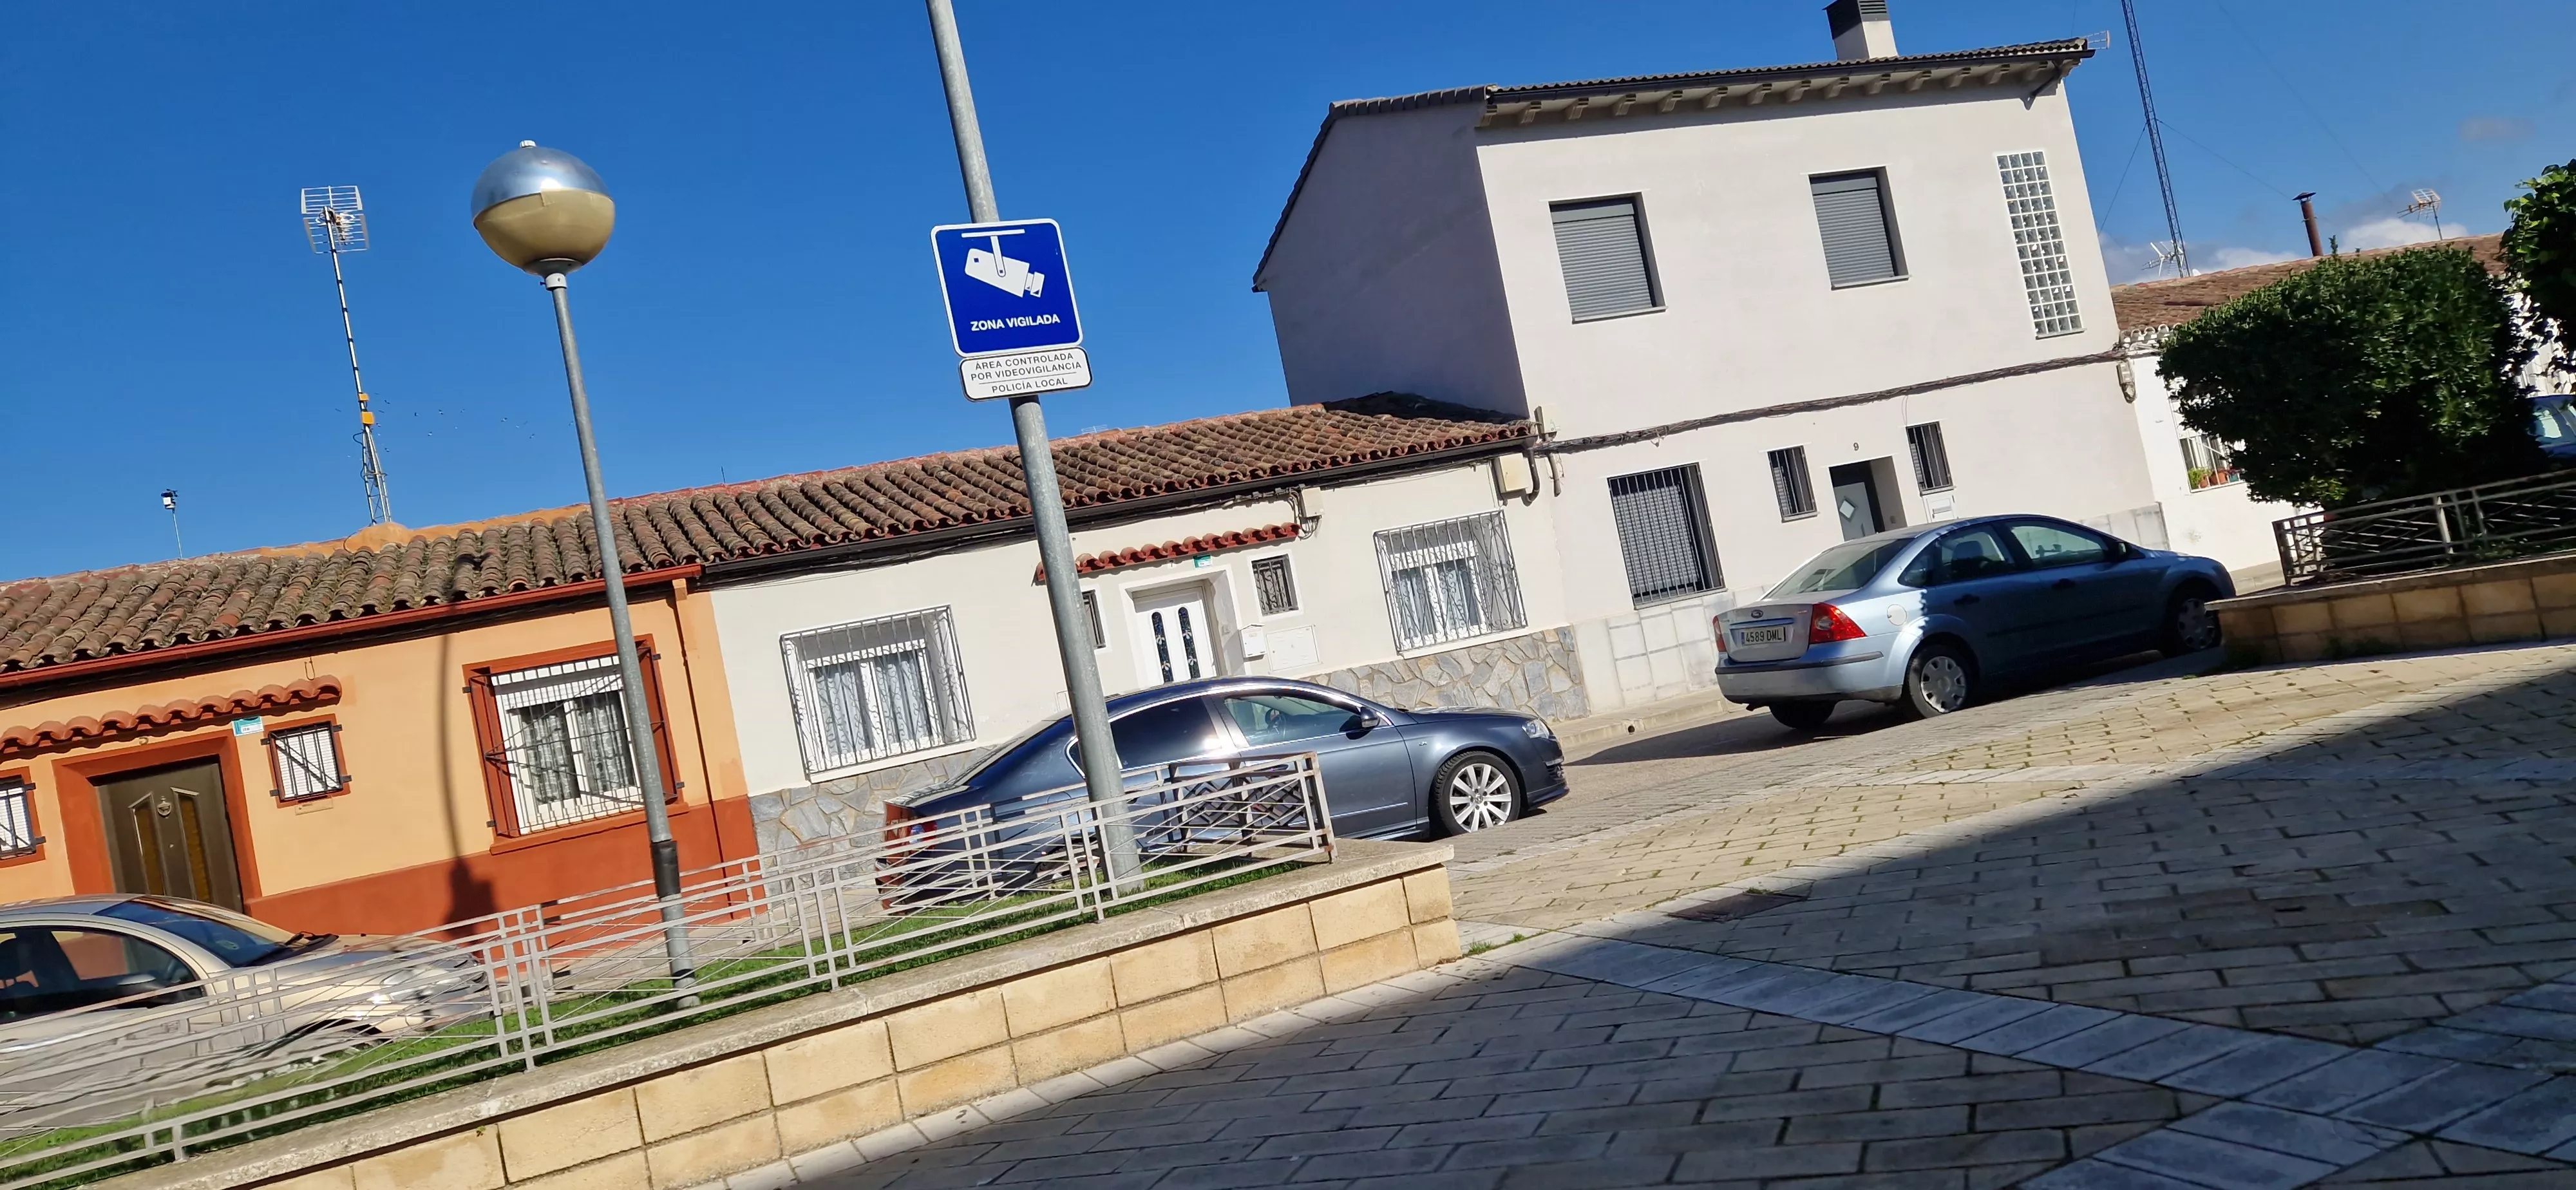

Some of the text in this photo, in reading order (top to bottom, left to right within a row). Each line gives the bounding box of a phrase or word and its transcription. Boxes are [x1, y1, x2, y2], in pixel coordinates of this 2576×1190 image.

[971, 314, 1061, 331] ZONA VIGILADA
[975, 352, 1074, 370] ÁREA CONTROLADA
[971, 361, 1082, 381] POR VIDEOVIGILANCIA
[992, 377, 1068, 393] POLICÍA LOCAL
[1853, 442, 1859, 451] 9
[1746, 628, 1782, 643] 4589 DML
